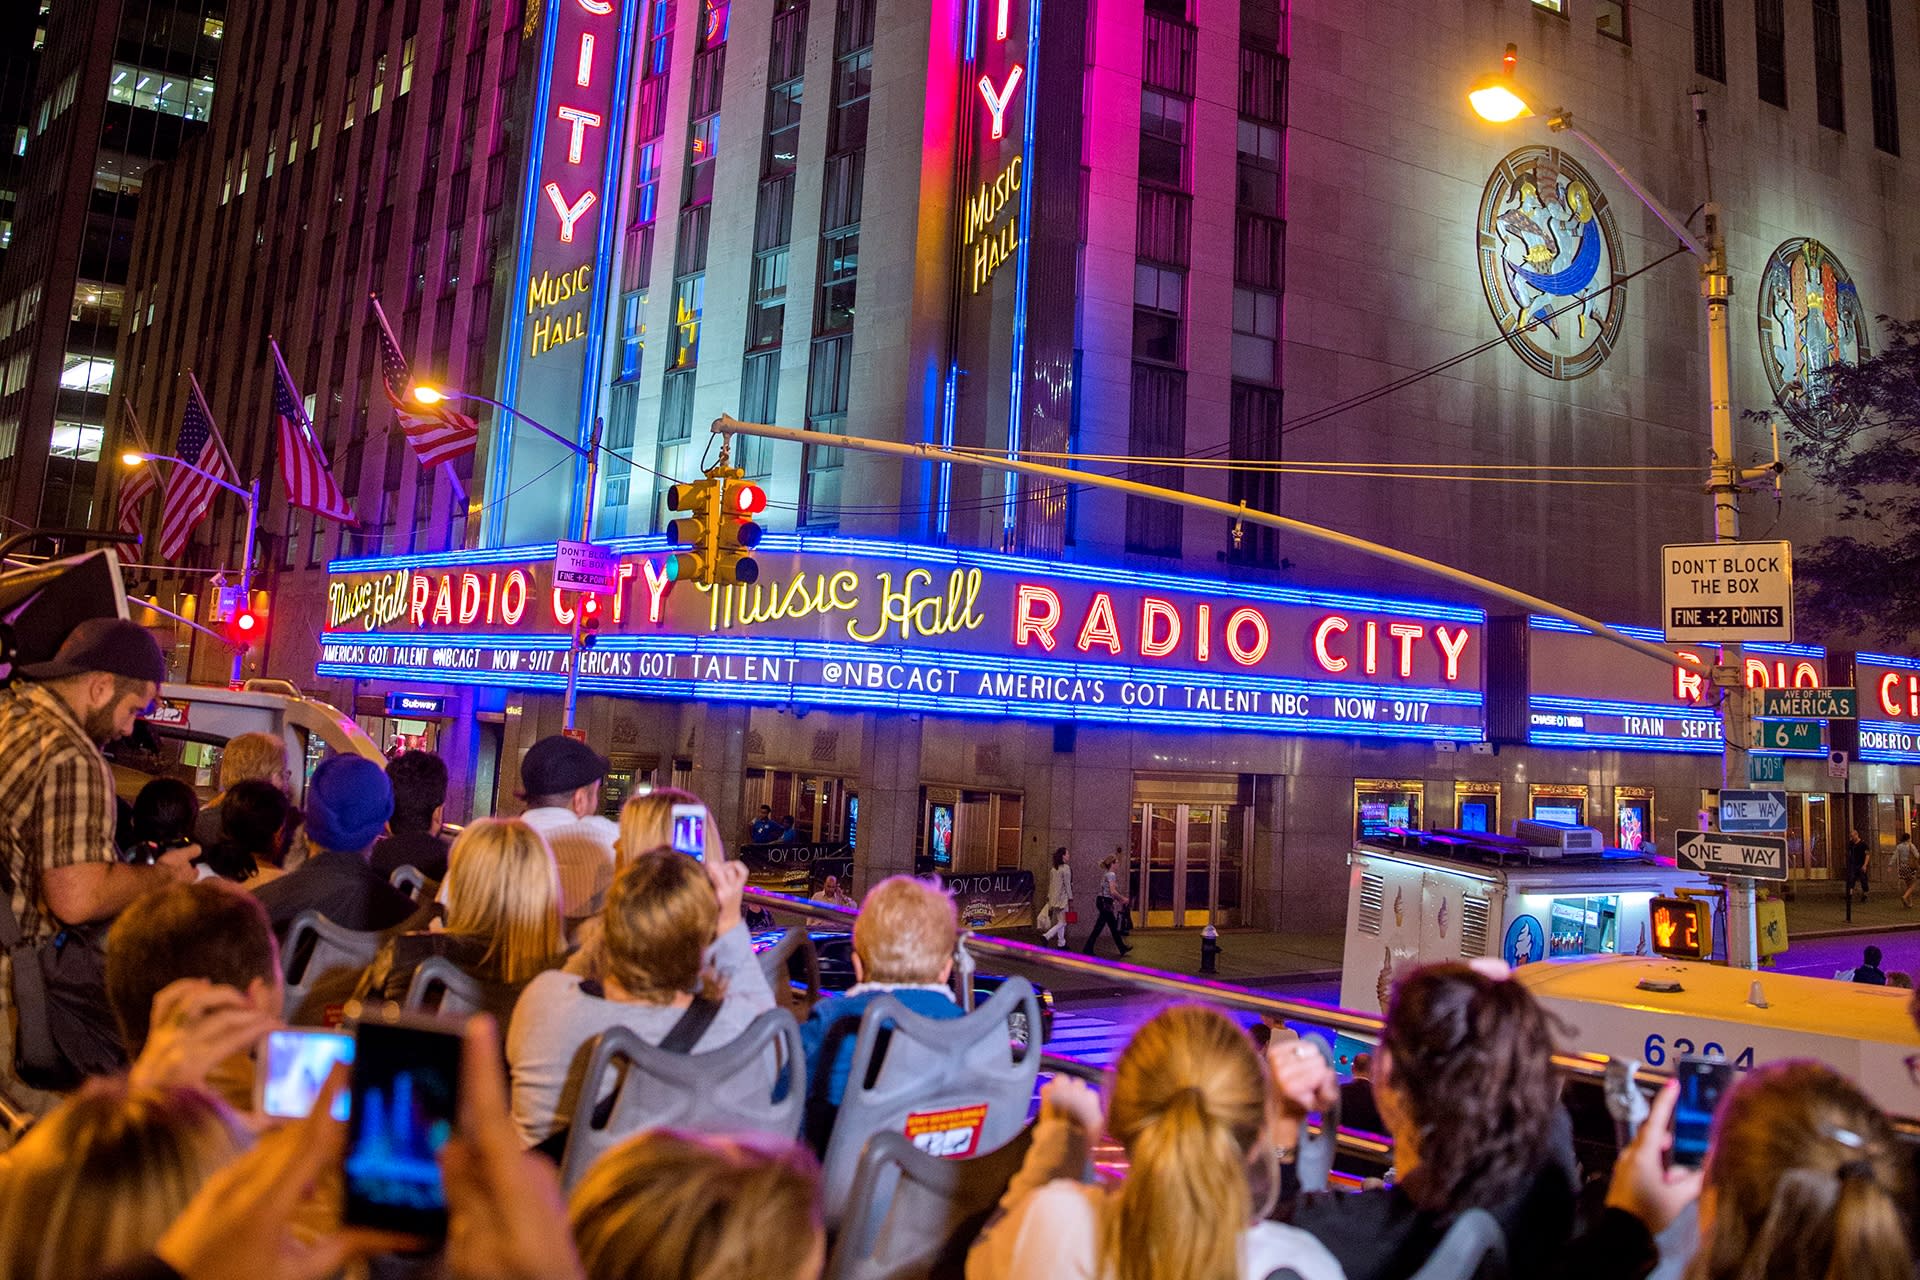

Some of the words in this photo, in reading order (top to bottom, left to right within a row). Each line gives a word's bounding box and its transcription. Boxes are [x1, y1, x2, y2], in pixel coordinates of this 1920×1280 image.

[545, 0, 613, 243] ITY
[969, 155, 1023, 244] MUSIC
[972, 216, 1019, 294] HALL
[528, 264, 590, 315] MUSIC
[531, 311, 585, 358] HALL
[561, 547, 586, 557] DON'T
[571, 558, 586, 567] THE
[1672, 558, 1717, 575] DON'T
[1724, 557, 1780, 574] BLOCK
[559, 571, 575, 581] FINE
[1691, 579, 1721, 594] THE
[1727, 578, 1760, 594] BOX
[329, 581, 372, 629] Music
[364, 568, 409, 632] Hall
[410, 569, 527, 627] RADIO
[553, 558, 672, 626] CTY
[846, 567, 985, 643] Hall
[1015, 583, 1270, 666] RADIO
[1314, 615, 1469, 680] CITY
[1675, 609, 1702, 626] FINE
[1706, 609, 1728, 625] +2
[1732, 608, 1779, 625] POINTS
[322, 644, 366, 664] AMERICA'S
[368, 645, 389, 665] GOT
[393, 646, 429, 667] TALENT
[432, 648, 482, 669] @NBCAGT
[491, 650, 520, 671] NOW
[1677, 651, 1819, 703] RDIO
[640, 653, 676, 678] GOT
[691, 654, 800, 682] TALENT
[822, 661, 960, 693] @NBCAGT
[977, 672, 1106, 704] AMERICA'S
[1120, 681, 1168, 707] GOT
[1184, 686, 1262, 713] TALENT
[1271, 693, 1310, 717] NBC
[1334, 697, 1377, 720] NOW
[1394, 701, 1430, 723] 9/17
[1784, 690, 1799, 699] AVE
[1803, 690, 1813, 699] OF
[1817, 689, 1833, 698] THE
[402, 698, 437, 711] Subway
[1768, 699, 1850, 715] AMERICAS
[1623, 717, 1664, 737] TRAIN
[1775, 724, 1790, 747] 6
[1794, 724, 1809, 737] AV
[1859, 731, 1912, 751] ROBERTO
[1762, 757, 1774, 780] 50
[1725, 802, 1748, 818] ONE
[1758, 802, 1780, 818] WAY
[767, 848, 789, 863] JOY
[791, 847, 810, 862] TO
[1688, 843, 1722, 861] ONE
[1741, 847, 1776, 866] WAY
[948, 878, 970, 895] JOY
[973, 877, 992, 894] TO
[994, 875, 1012, 892] ALL
